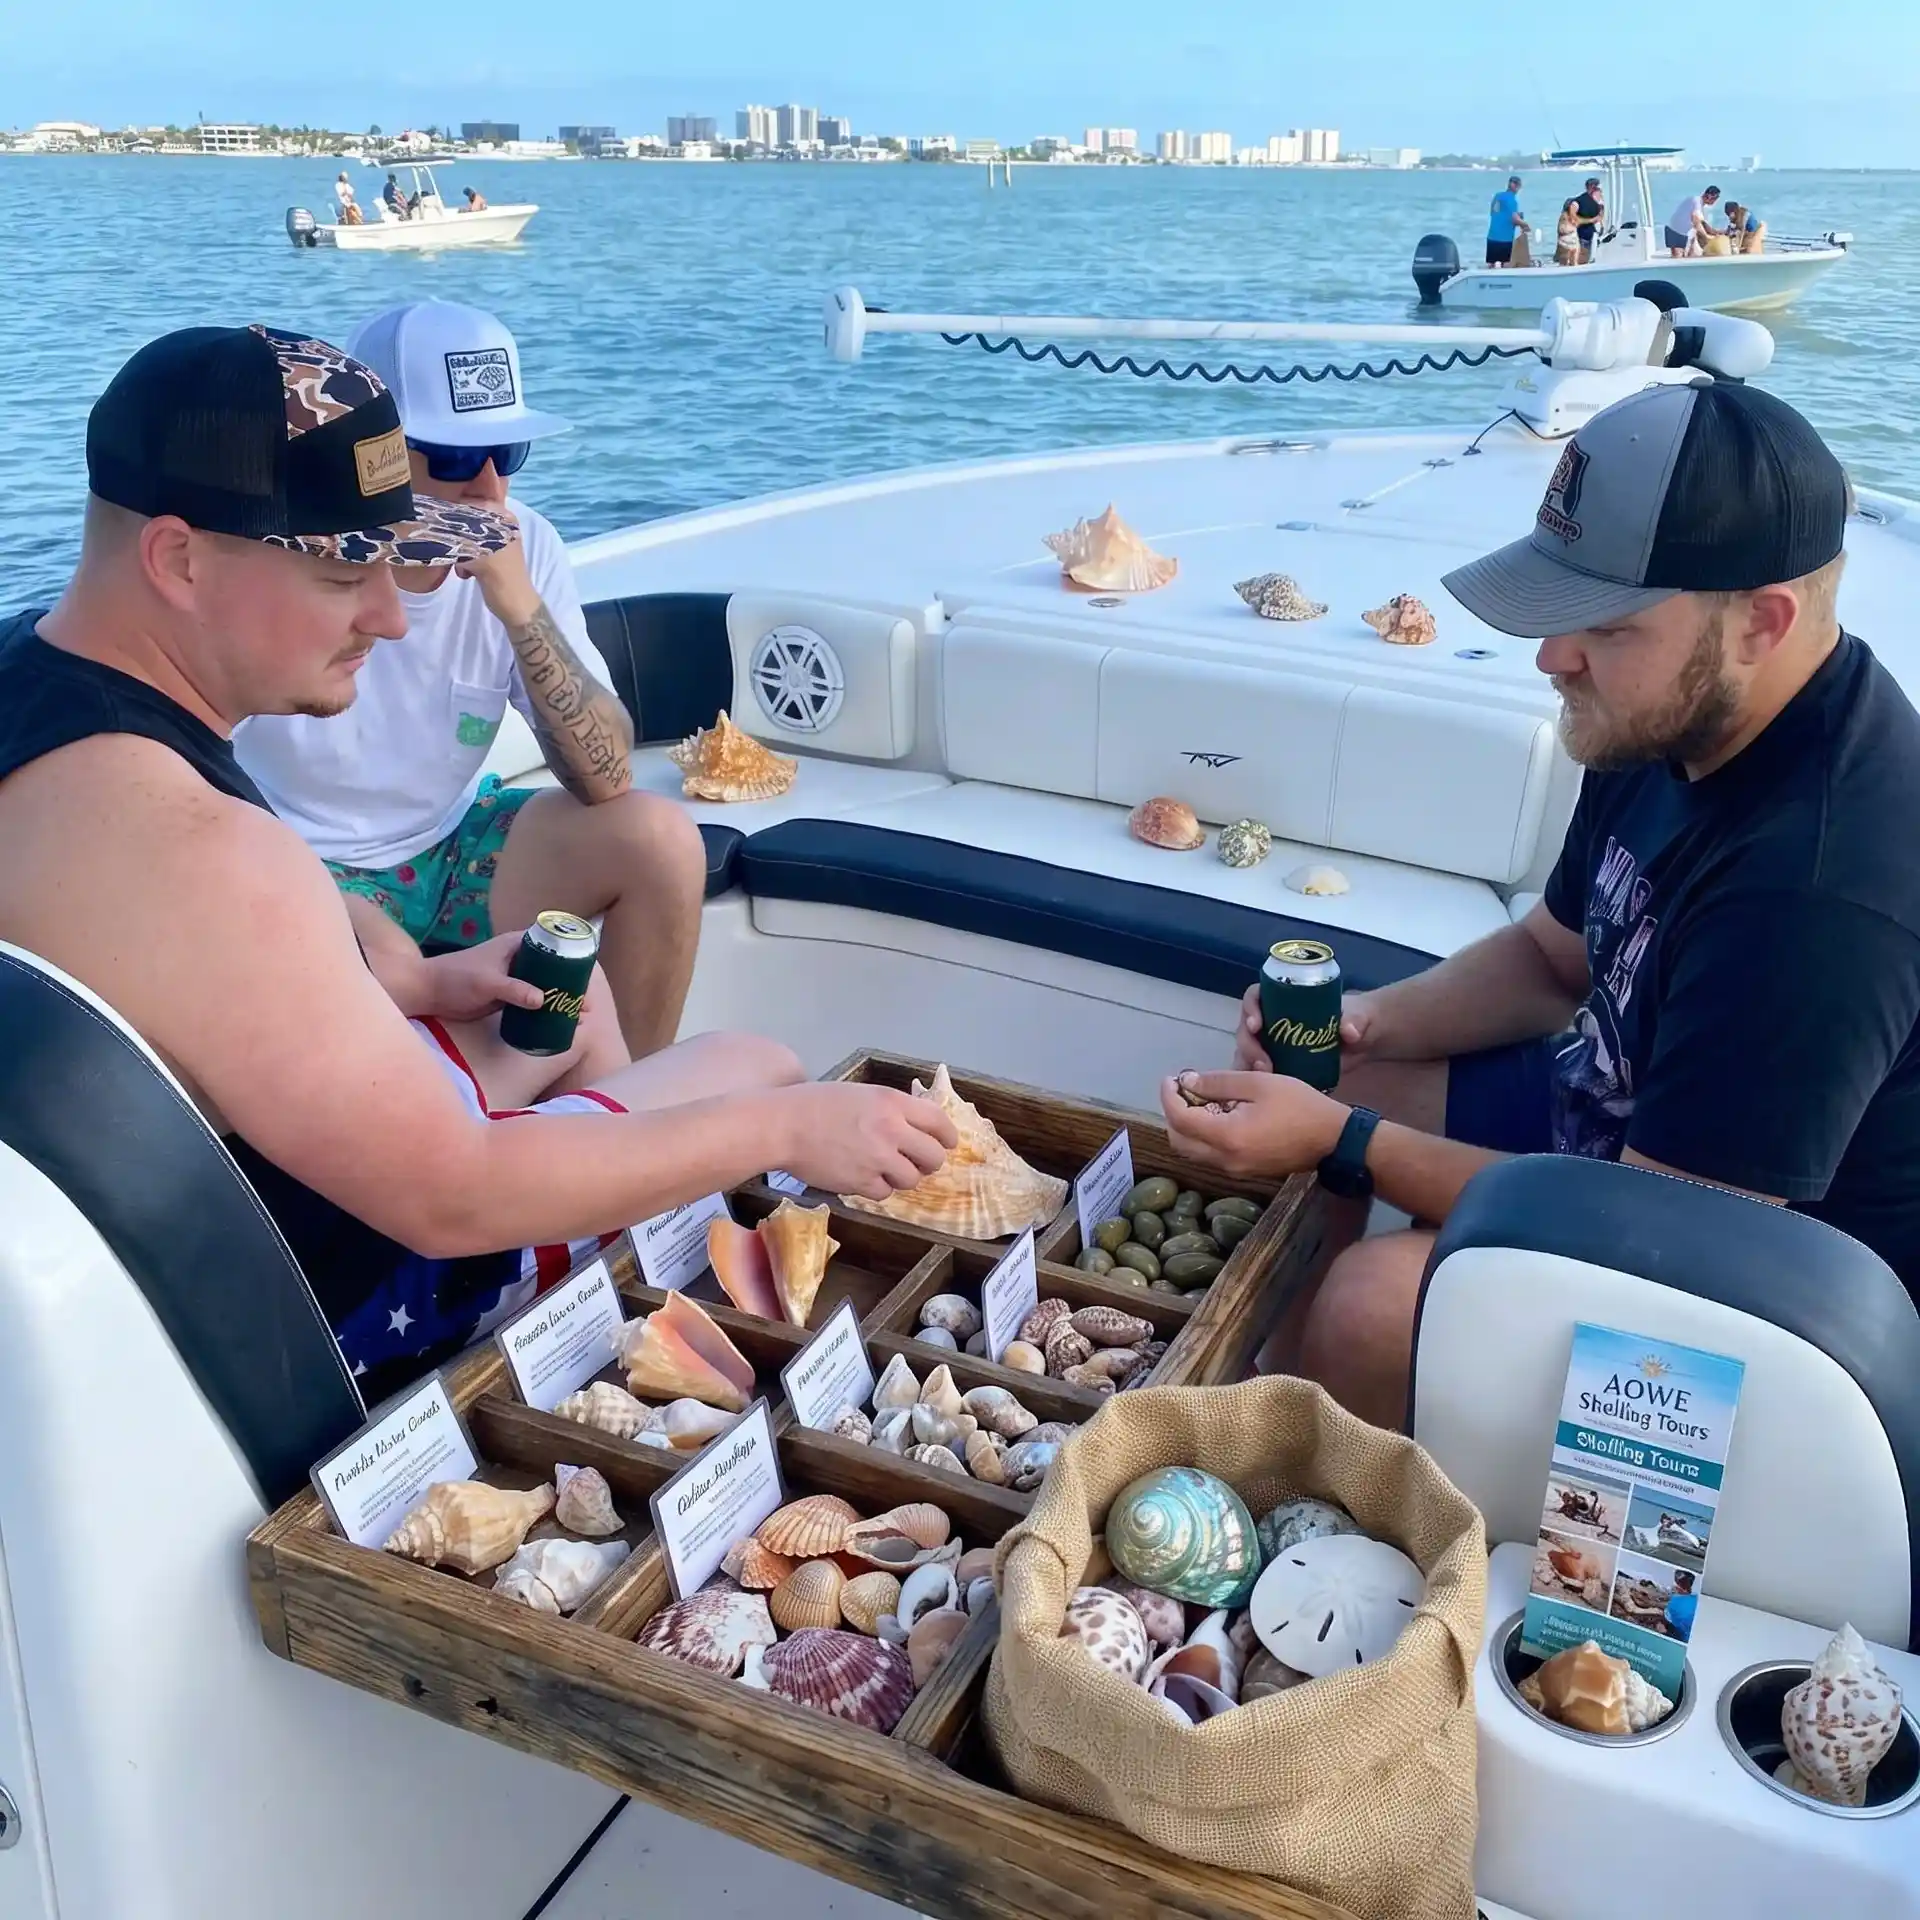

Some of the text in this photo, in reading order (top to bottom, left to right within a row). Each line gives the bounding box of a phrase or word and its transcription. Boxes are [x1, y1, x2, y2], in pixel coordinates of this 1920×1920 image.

[1604, 1374, 1691, 1412] AOWE
[1579, 1392, 1651, 1430] Shelling
[1657, 1412, 1710, 1440] Tours
